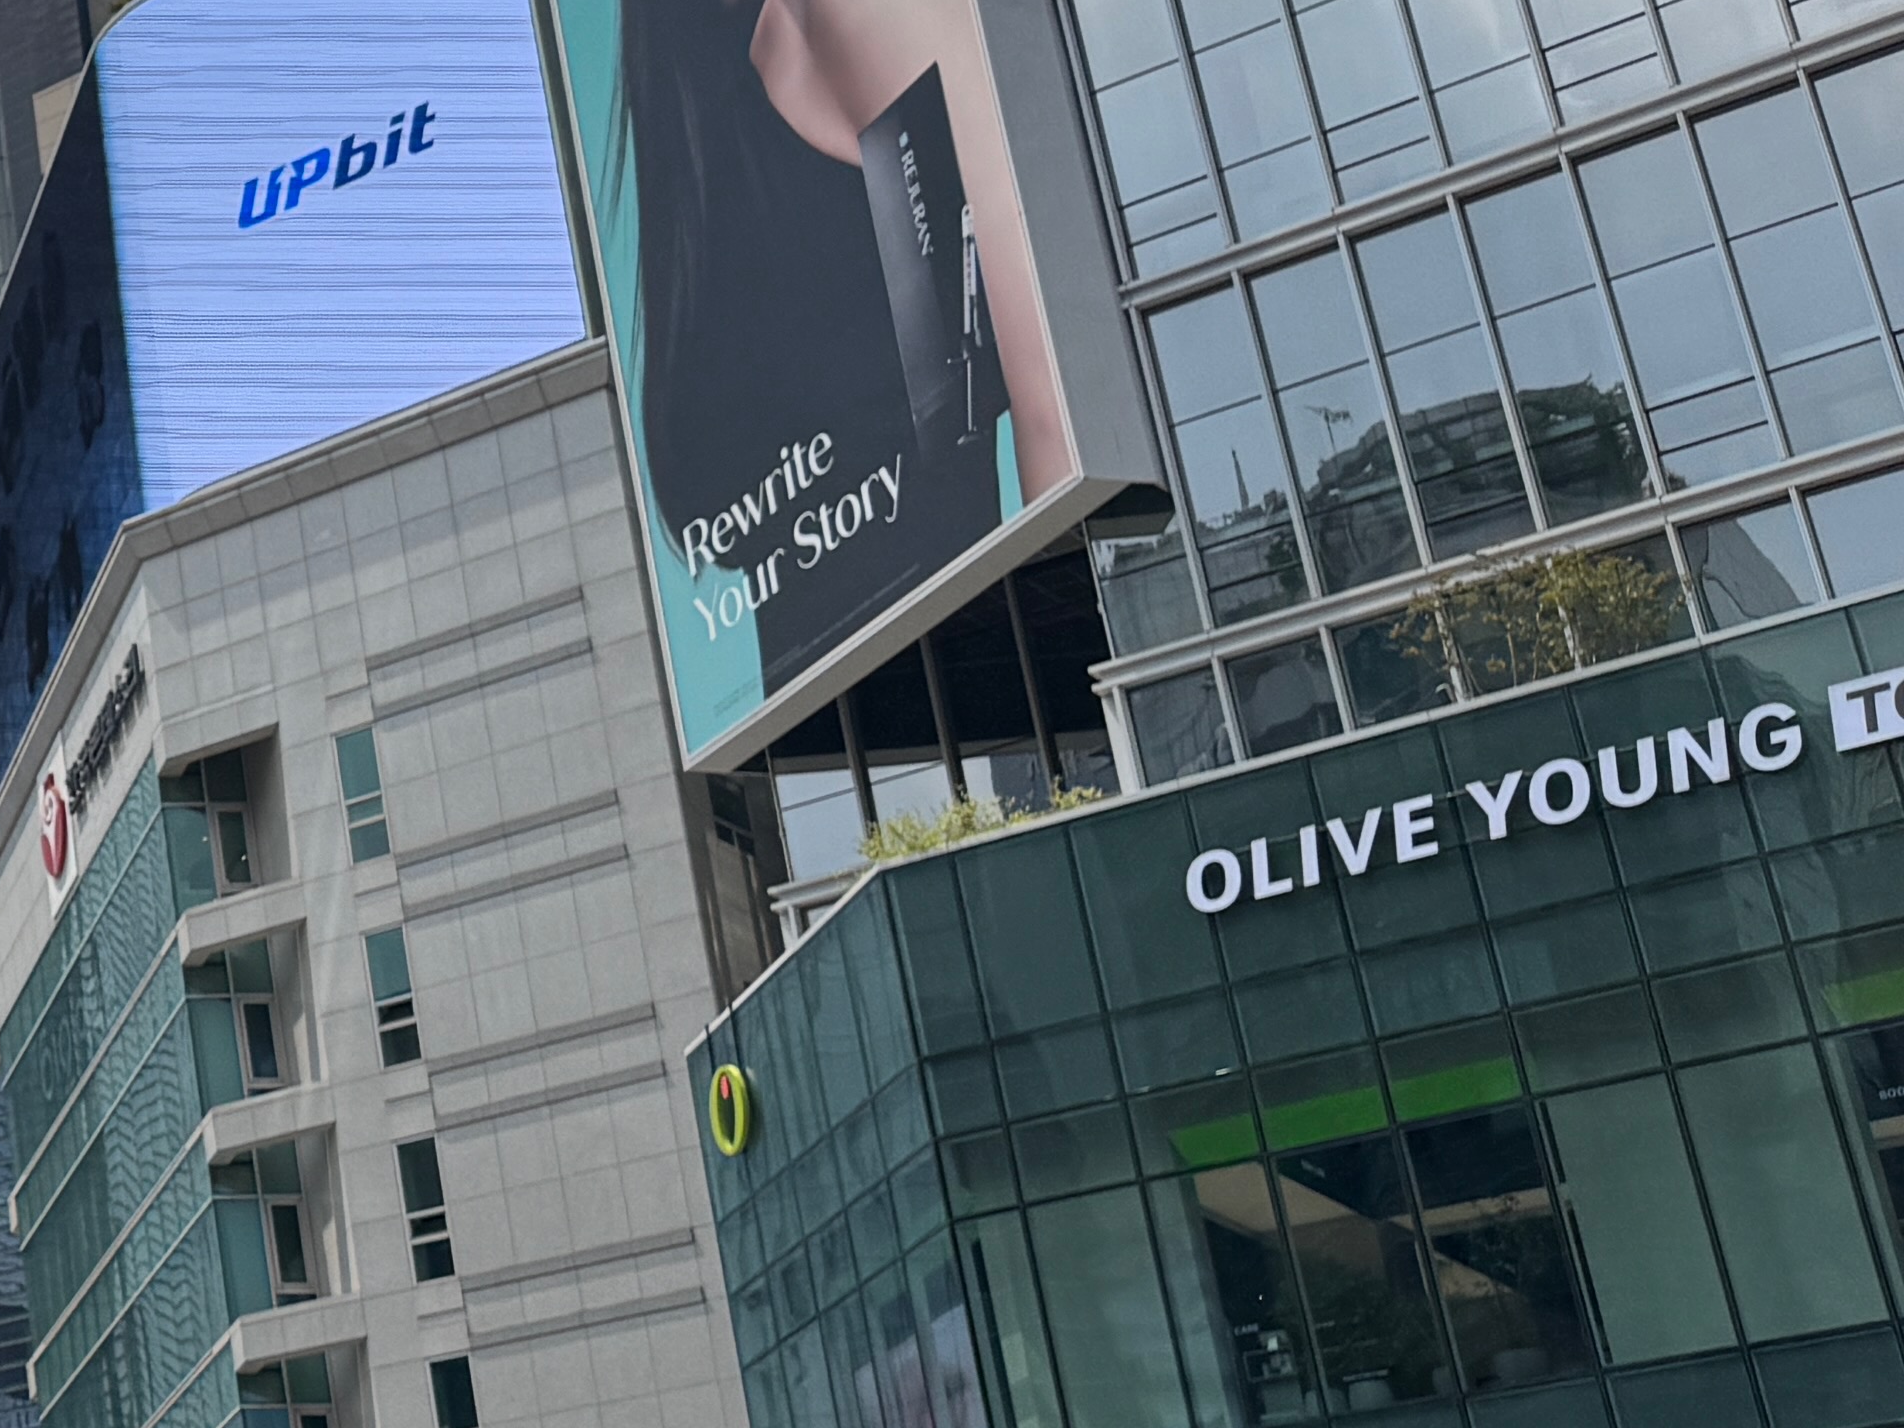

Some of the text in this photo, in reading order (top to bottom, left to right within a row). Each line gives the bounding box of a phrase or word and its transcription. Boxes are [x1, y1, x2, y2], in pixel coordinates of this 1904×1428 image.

[682, 431, 835, 577] Rewrite
[693, 547, 786, 642] Your
[791, 453, 903, 570] Story
[1185, 678, 1904, 915] OLIVE YOUNG T
